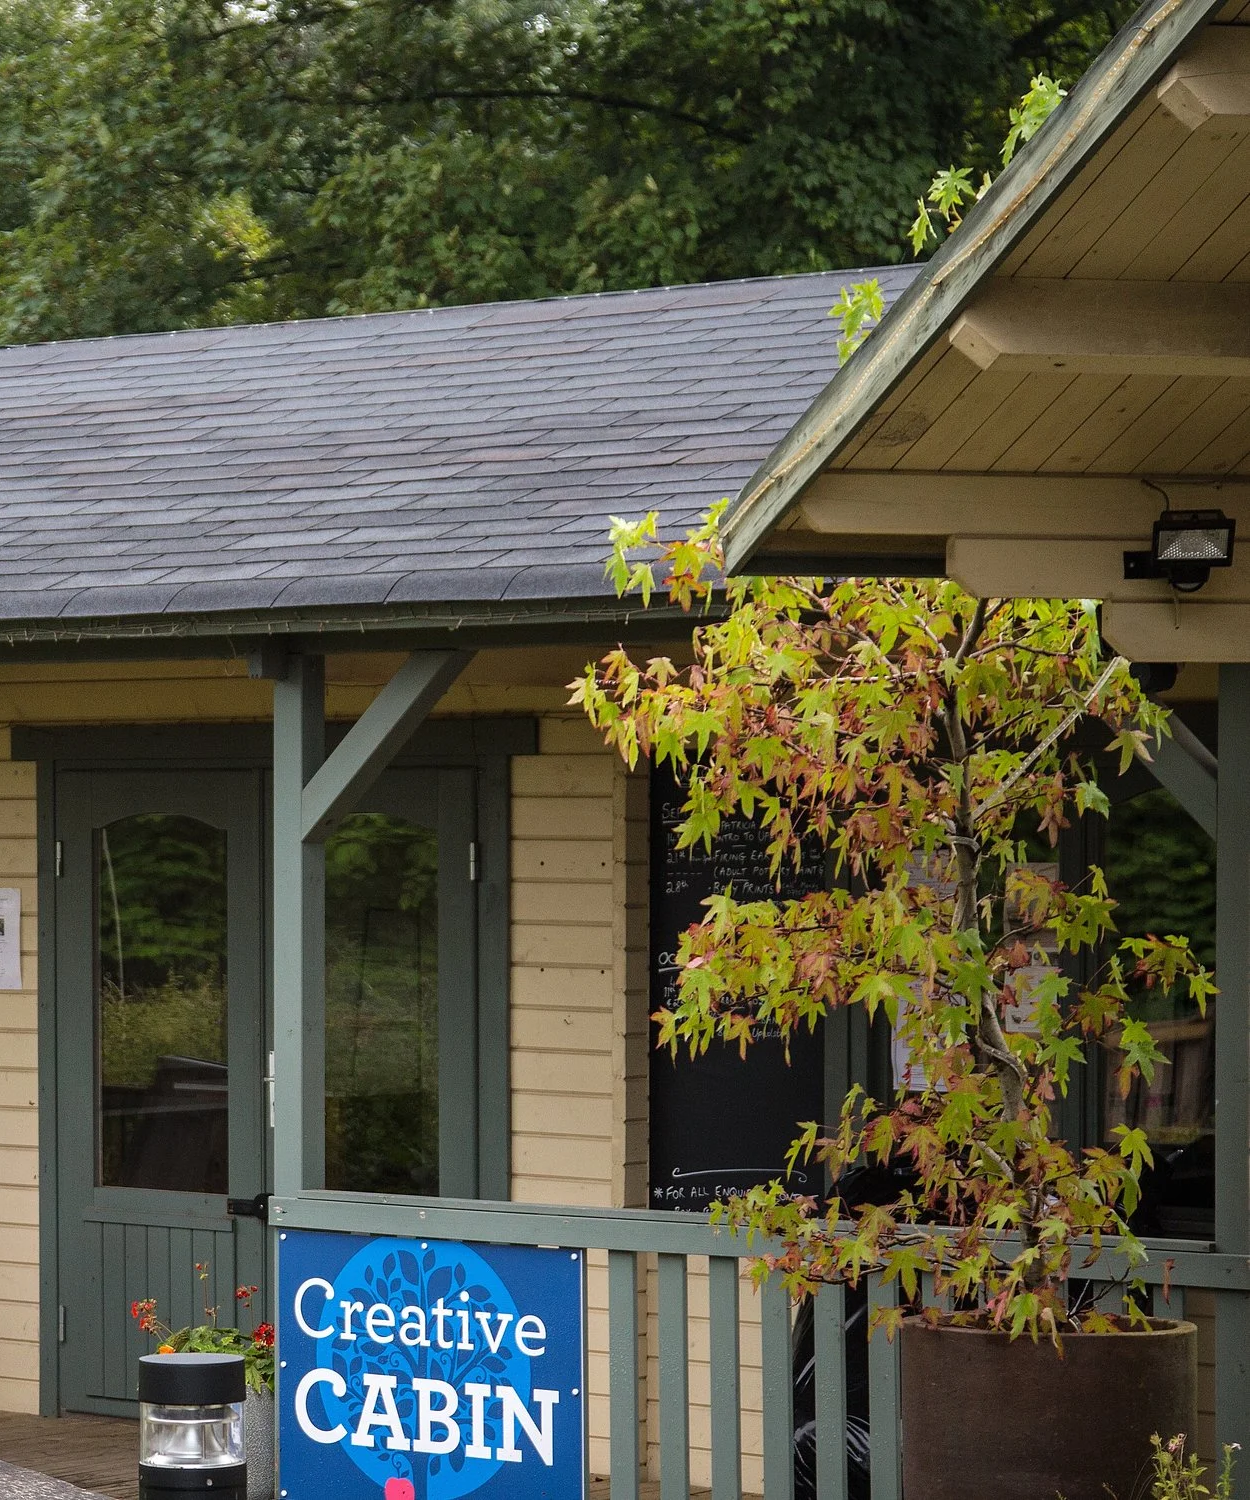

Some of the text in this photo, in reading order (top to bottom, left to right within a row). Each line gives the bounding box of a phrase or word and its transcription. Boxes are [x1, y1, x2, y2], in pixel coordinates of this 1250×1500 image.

[743, 833, 754, 842] TO
[713, 848, 748, 863] FIRING
[742, 880, 775, 895] PRINTS
[665, 1186, 684, 1200] FOR
[691, 1186, 710, 1198] ALL
[294, 1277, 547, 1357] Creative
[294, 1367, 560, 1467] CABIN
